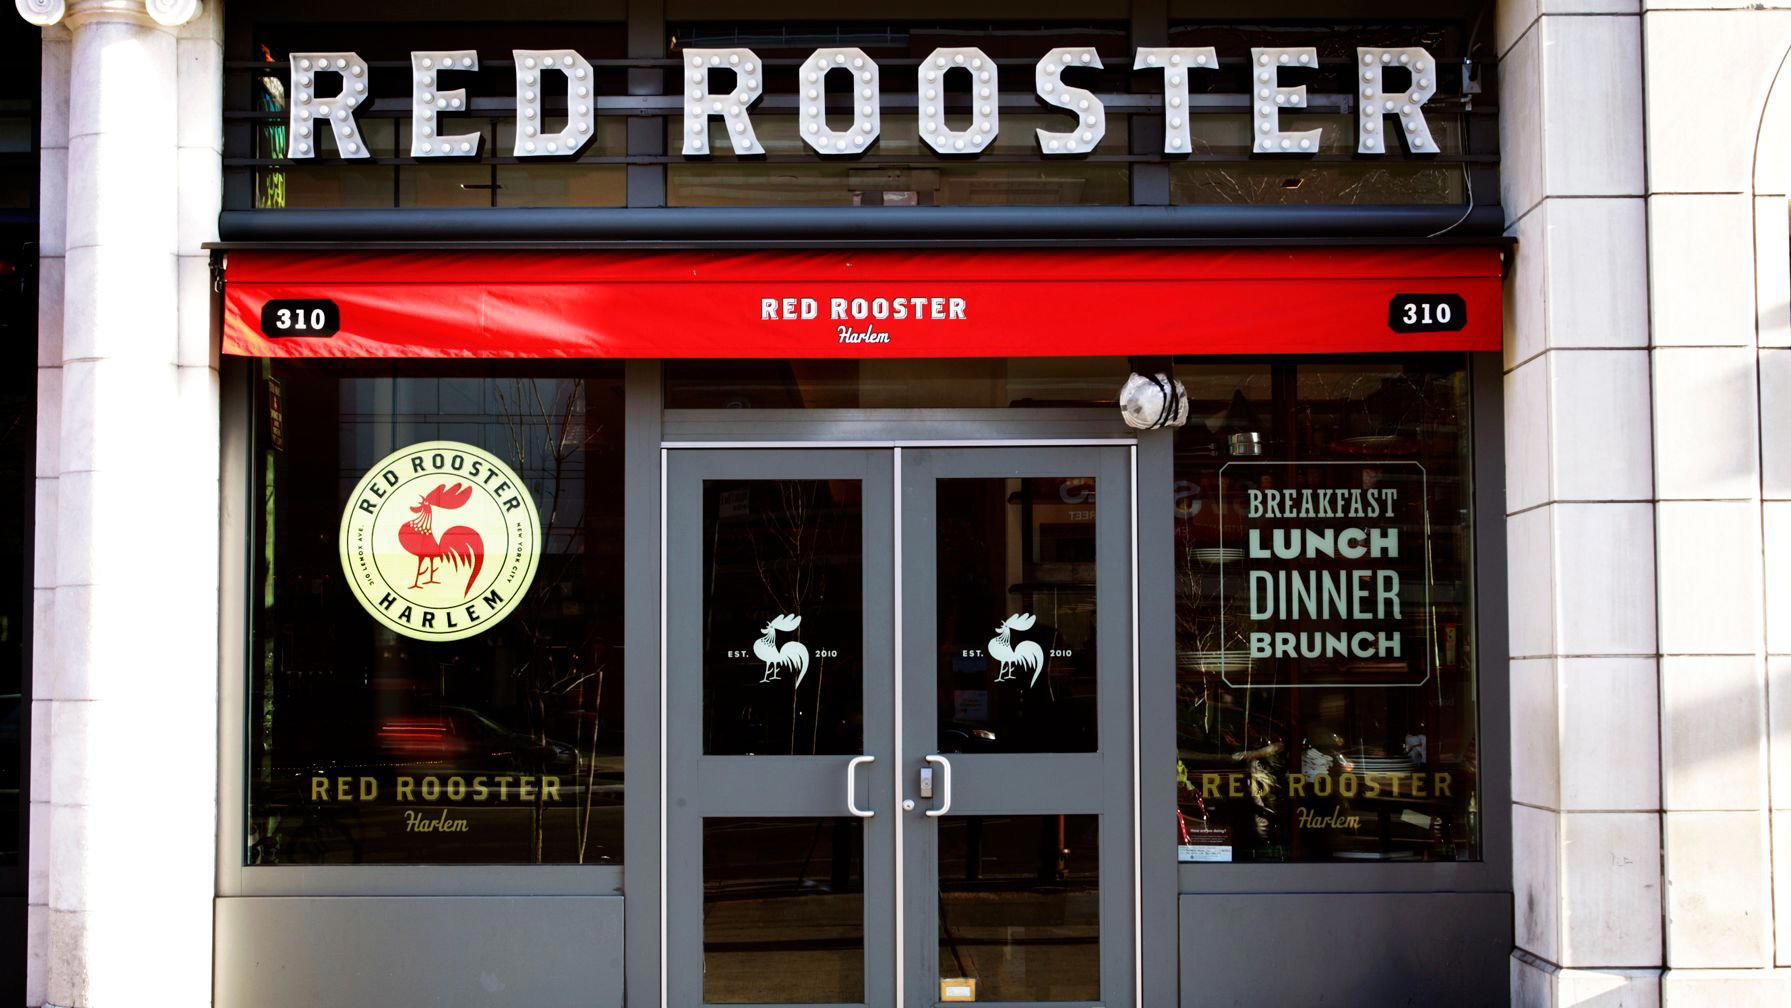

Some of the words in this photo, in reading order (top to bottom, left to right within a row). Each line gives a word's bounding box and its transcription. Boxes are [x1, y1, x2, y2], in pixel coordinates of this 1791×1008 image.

[288, 49, 595, 159] RED
[682, 47, 1441, 156] ROOSTER
[276, 308, 325, 330] 310
[761, 298, 818, 320] RED
[830, 298, 967, 320] ROOSTER
[1402, 303, 1451, 324] 310
[837, 324, 890, 343] Harlem
[358, 469, 399, 515] RED
[411, 453, 521, 513] ROOSTER
[1248, 488, 1397, 518] BREAKFAST
[515, 541, 523, 563] YORK
[1249, 527, 1398, 560] LUNCH
[358, 545, 368, 571] LENOX
[506, 565, 518, 583] CITY
[1249, 569, 1402, 621] DINNER
[378, 588, 505, 629] HARLEM
[728, 650, 749, 658] EST.
[815, 650, 838, 658] 2010
[1050, 649, 1072, 657] 2010
[1250, 631, 1401, 658] BRUNCH
[311, 776, 379, 801] RED
[397, 776, 562, 801] ROOSTER
[1288, 772, 1452, 798] ROOSTER
[404, 809, 469, 832] Harlem
[1297, 805, 1361, 829] Harlem
